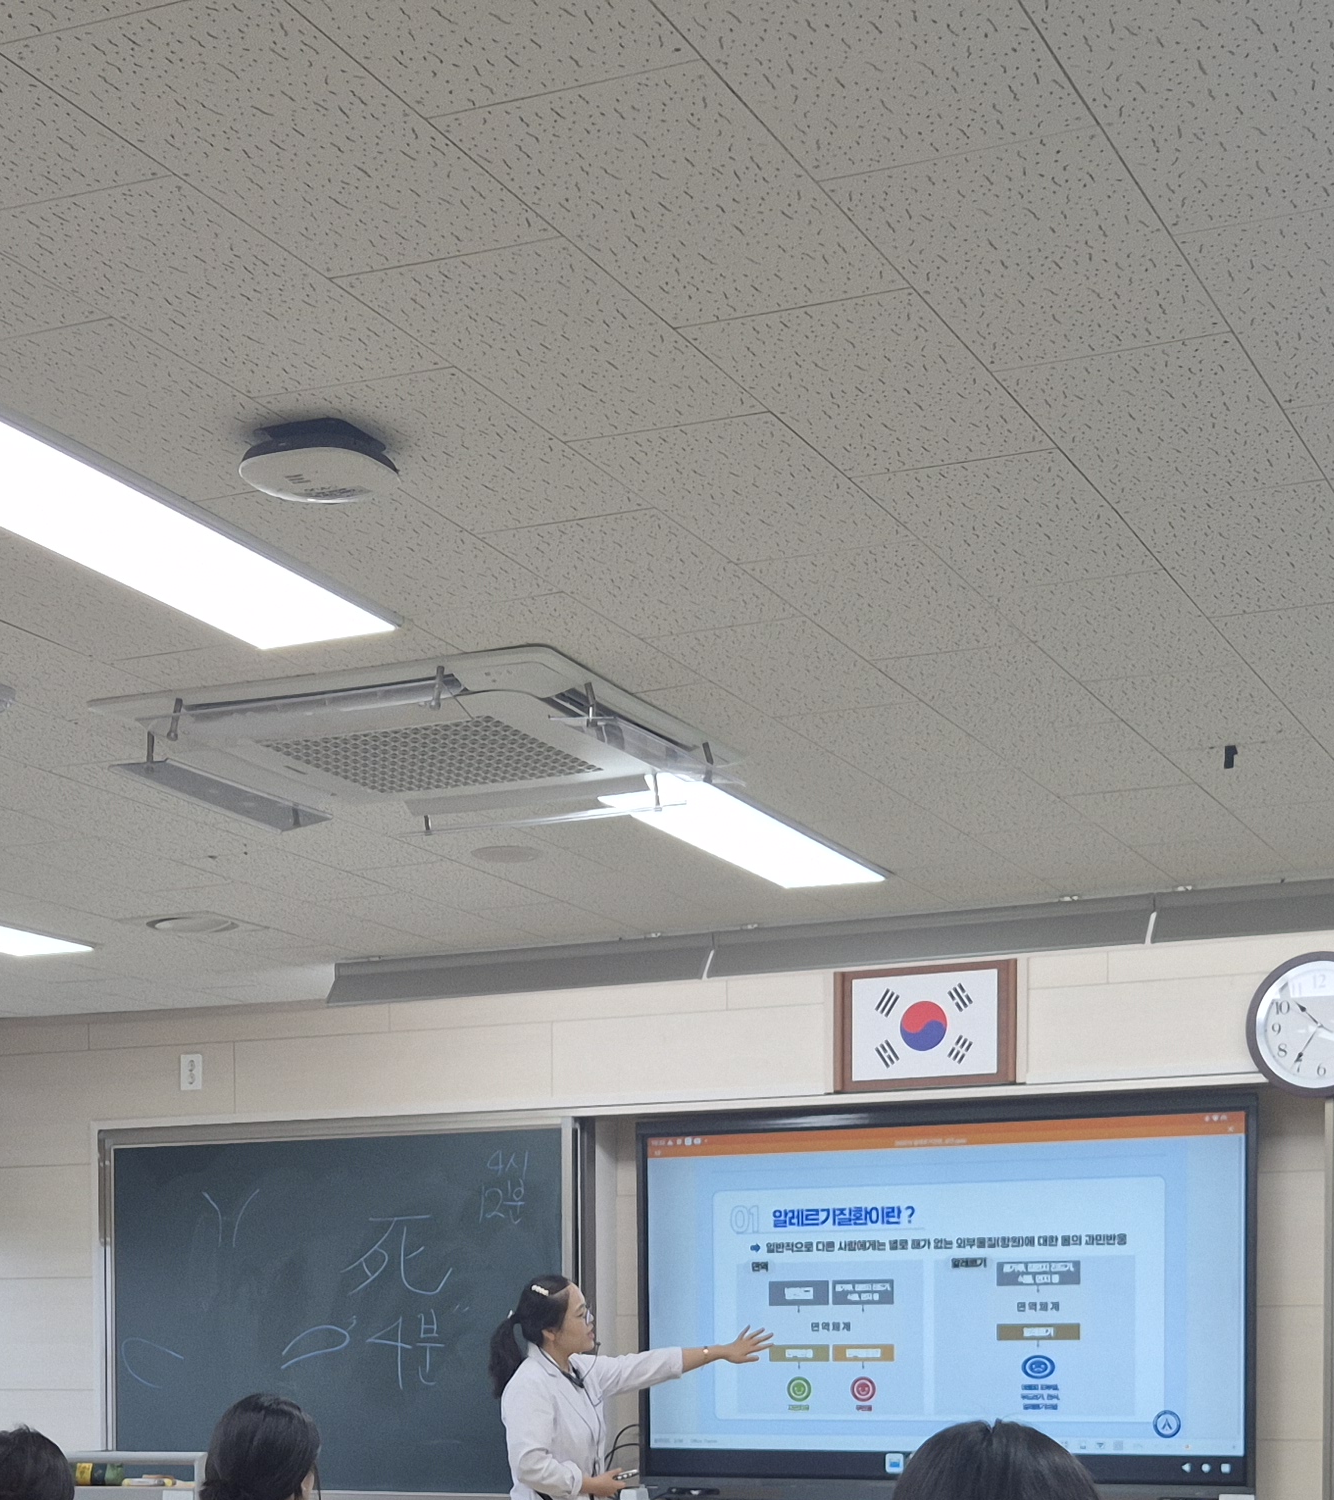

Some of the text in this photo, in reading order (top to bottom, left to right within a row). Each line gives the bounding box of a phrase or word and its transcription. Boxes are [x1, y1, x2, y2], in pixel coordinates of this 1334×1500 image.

[1312, 974, 1326, 989] 12
[1275, 1000, 1290, 1015] 10
[1271, 1023, 1281, 1035] 9
[1277, 1043, 1287, 1058] 8
[1317, 1063, 1326, 1077] 6
[730, 1205, 760, 1234] 01
[772, 1206, 902, 1228] 알레르기질환이란
[766, 1241, 814, 1253] 일반적으로
[816, 1240, 836, 1252] 다른
[1037, 1234, 1058, 1247] 대한
[1084, 1232, 1127, 1246] 과민반응
[340, 1214, 454, 1296] 死
